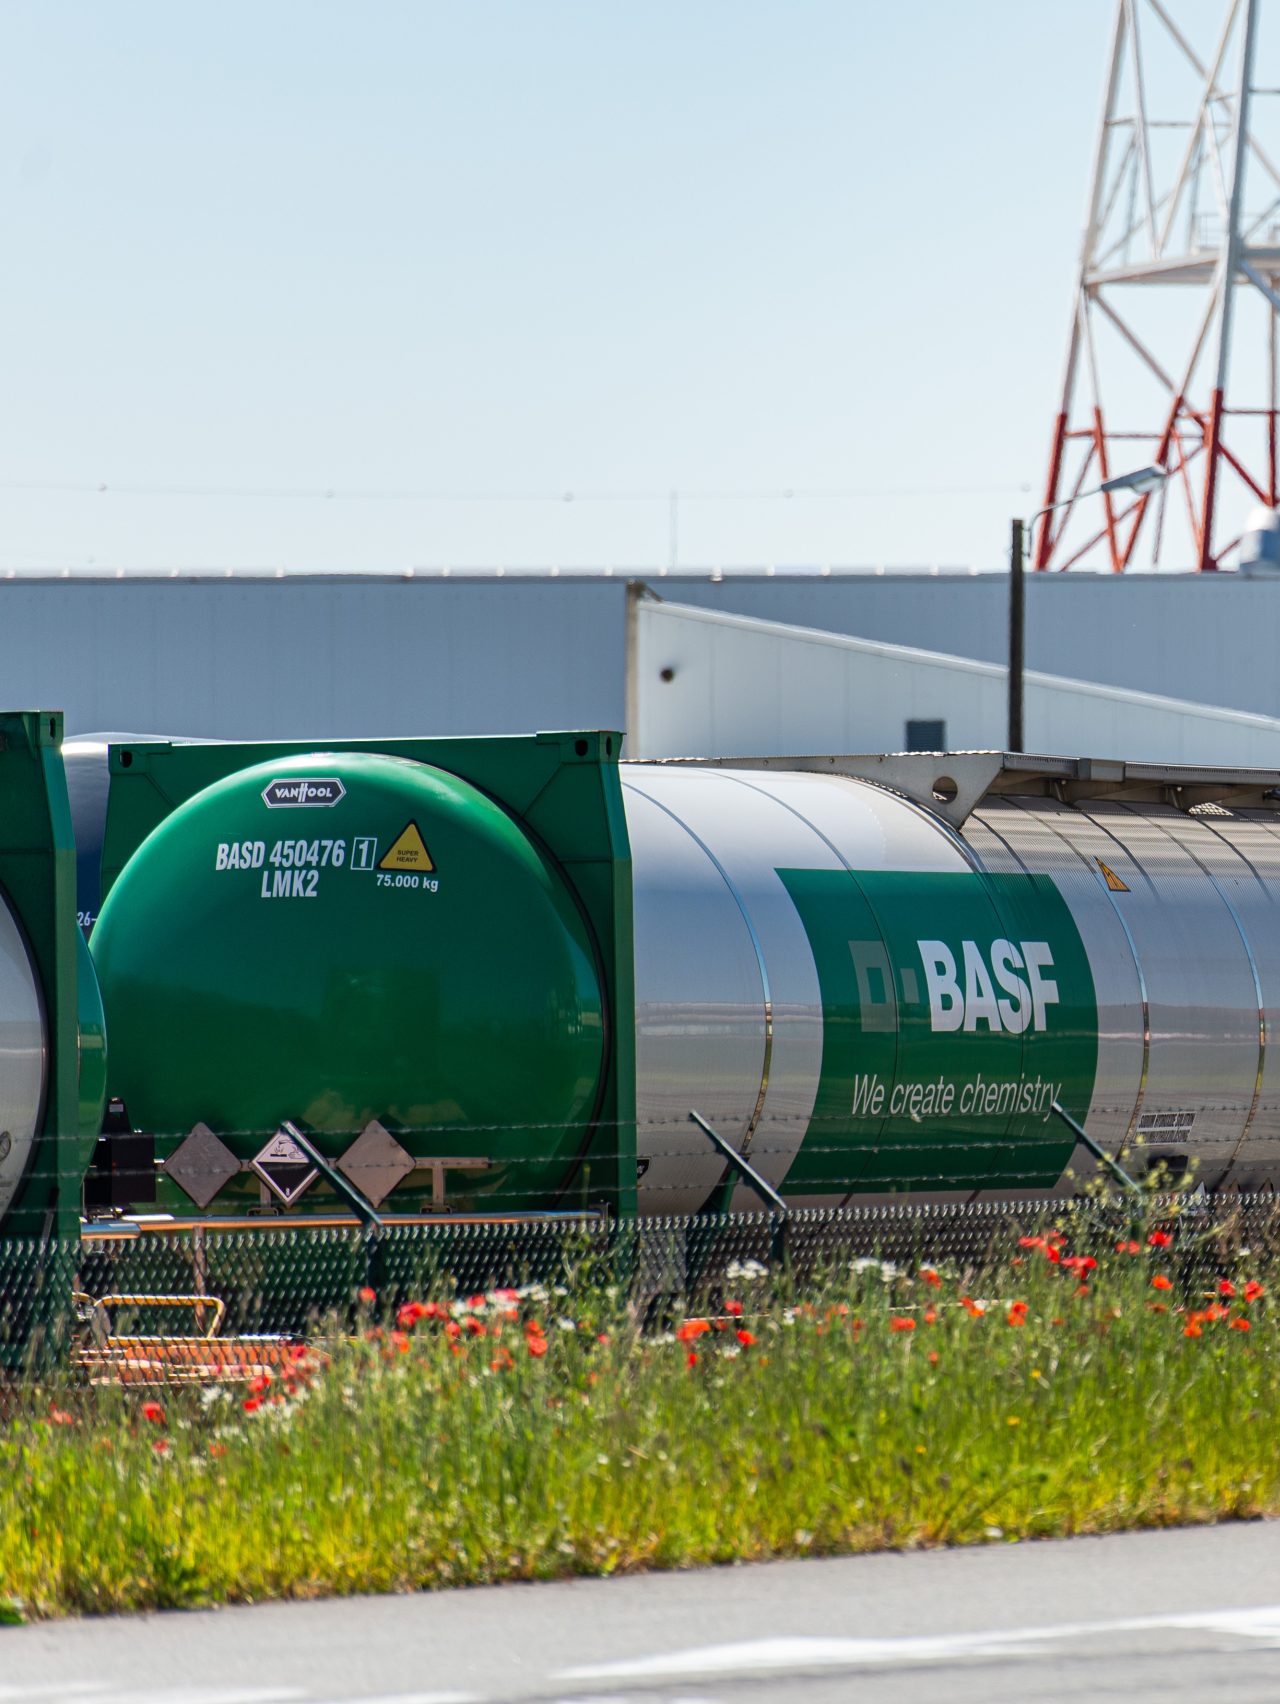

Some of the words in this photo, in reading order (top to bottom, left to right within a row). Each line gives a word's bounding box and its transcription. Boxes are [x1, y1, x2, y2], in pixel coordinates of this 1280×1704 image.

[215, 841, 266, 871] BASD
[269, 839, 346, 868] 450476
[358, 840, 369, 867] 1
[261, 870, 319, 898] LMK2
[376, 874, 419, 888] 75.000
[422, 876, 439, 893] kg
[917, 938, 1060, 1035] BASF
[851, 1073, 885, 1115] We
[890, 1075, 955, 1115] create
[959, 1072, 1062, 1122] chemistry
